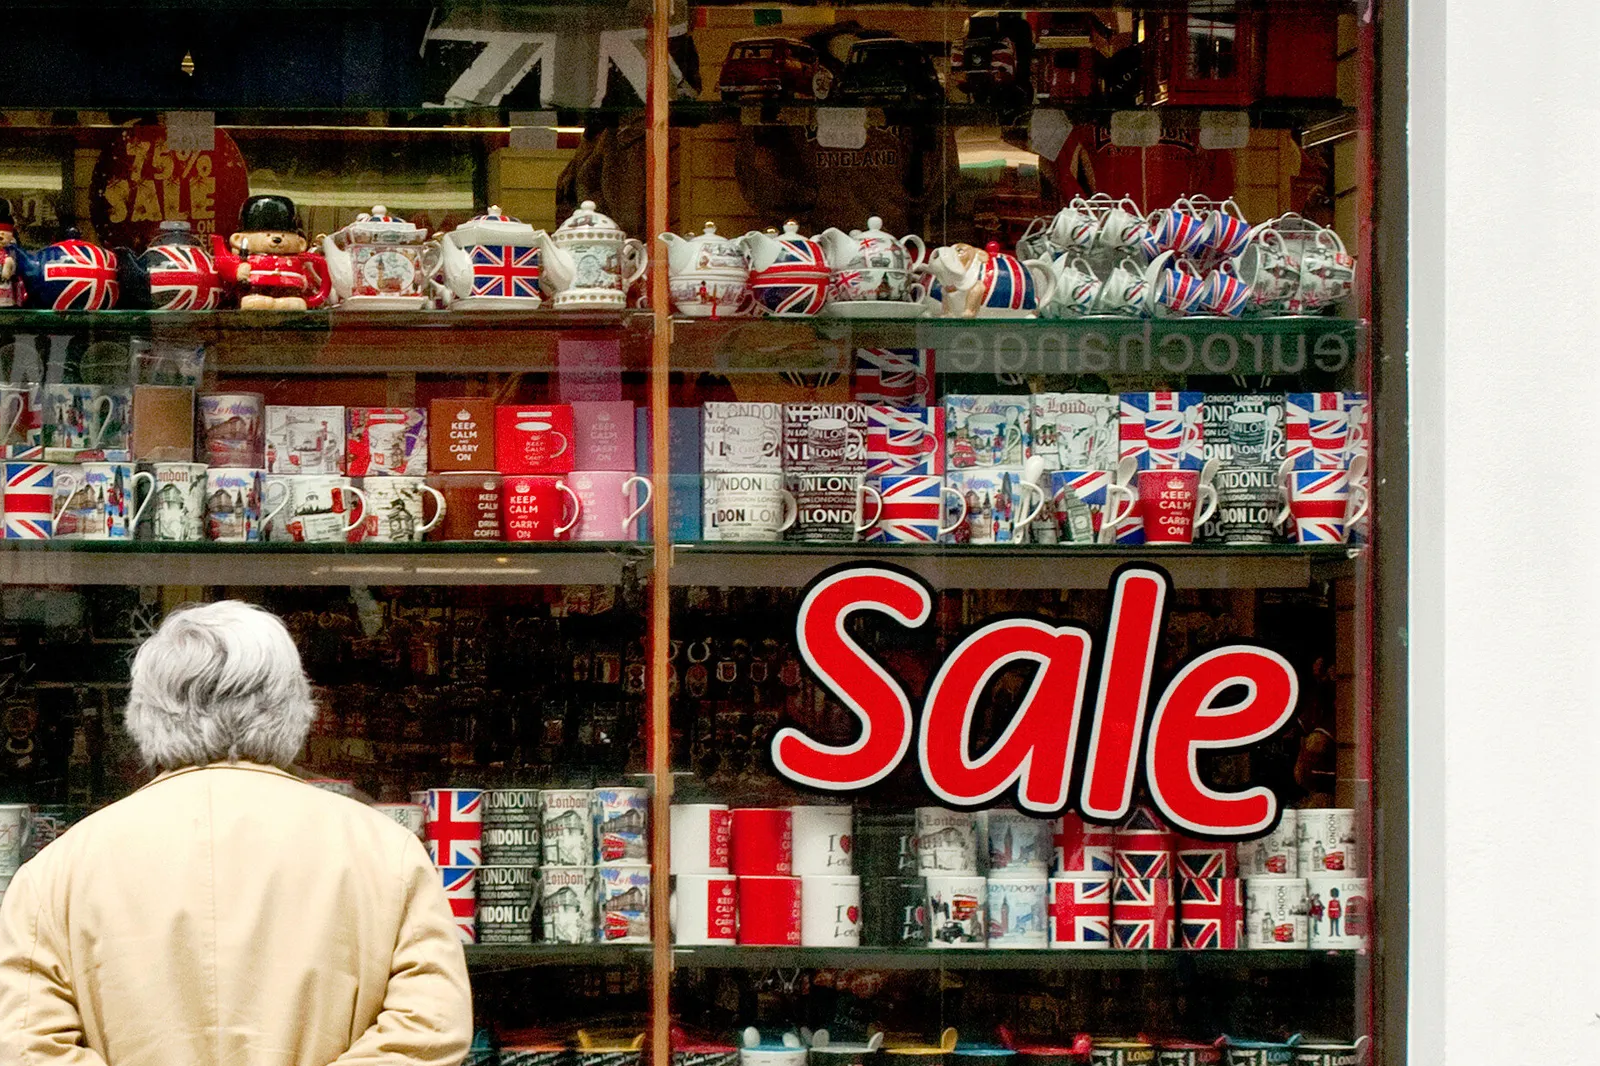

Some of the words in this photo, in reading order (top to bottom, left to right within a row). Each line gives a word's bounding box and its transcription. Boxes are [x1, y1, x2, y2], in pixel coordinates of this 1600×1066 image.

[104, 178, 216, 224] SALE
[1161, 491, 1191, 500] KEEP
[510, 496, 536, 505] KEEP
[509, 505, 538, 515] CALM
[1159, 501, 1191, 510] CALM
[509, 520, 540, 530] CARRY
[1159, 516, 1191, 525] CARRY
[516, 530, 532, 539] ON
[1168, 526, 1185, 536] ON
